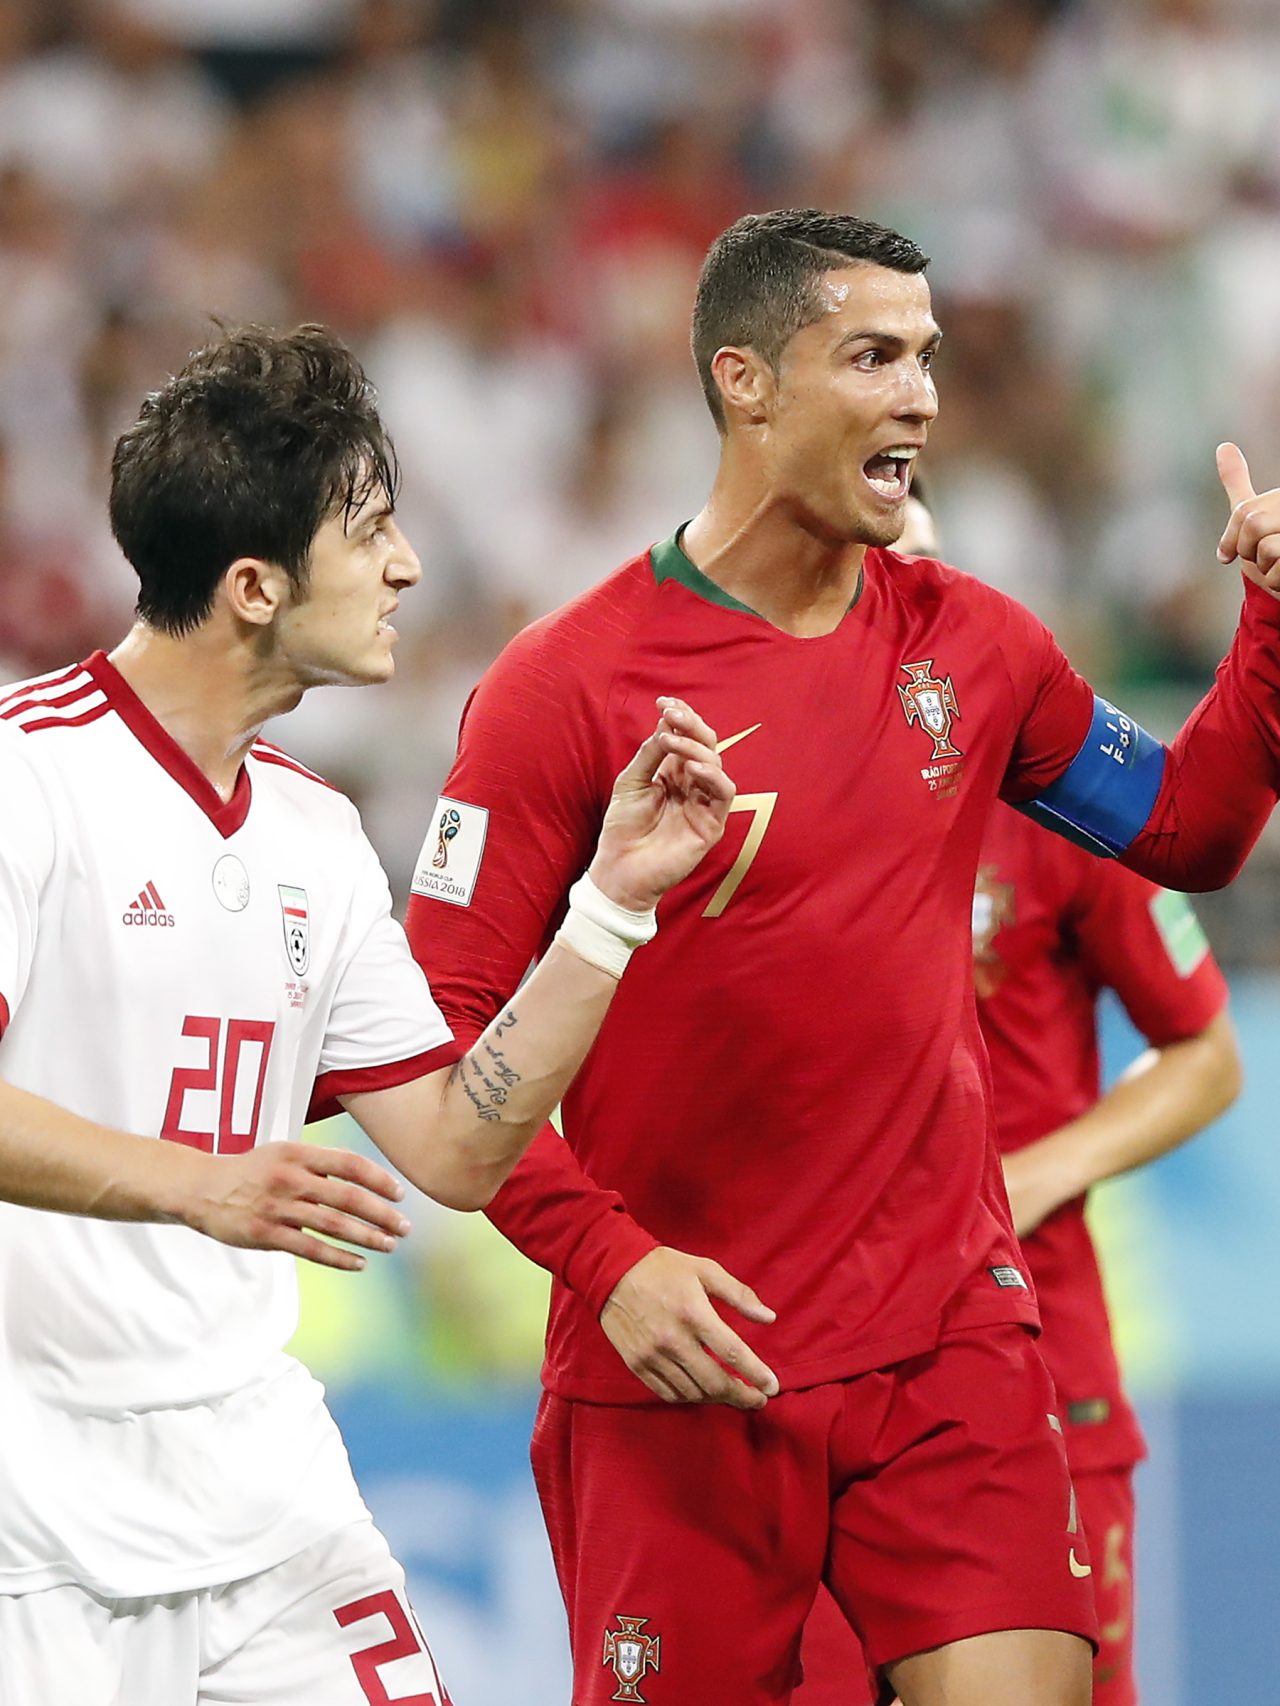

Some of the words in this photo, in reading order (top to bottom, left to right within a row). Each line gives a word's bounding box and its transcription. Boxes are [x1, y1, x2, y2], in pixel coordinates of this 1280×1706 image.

[414, 875, 439, 890] USSIA
[440, 882, 467, 897] 2018
[701, 791, 778, 917] 7
[122, 909, 175, 928] adidas
[159, 1015, 276, 1155] 20
[333, 1589, 453, 1706] 2
